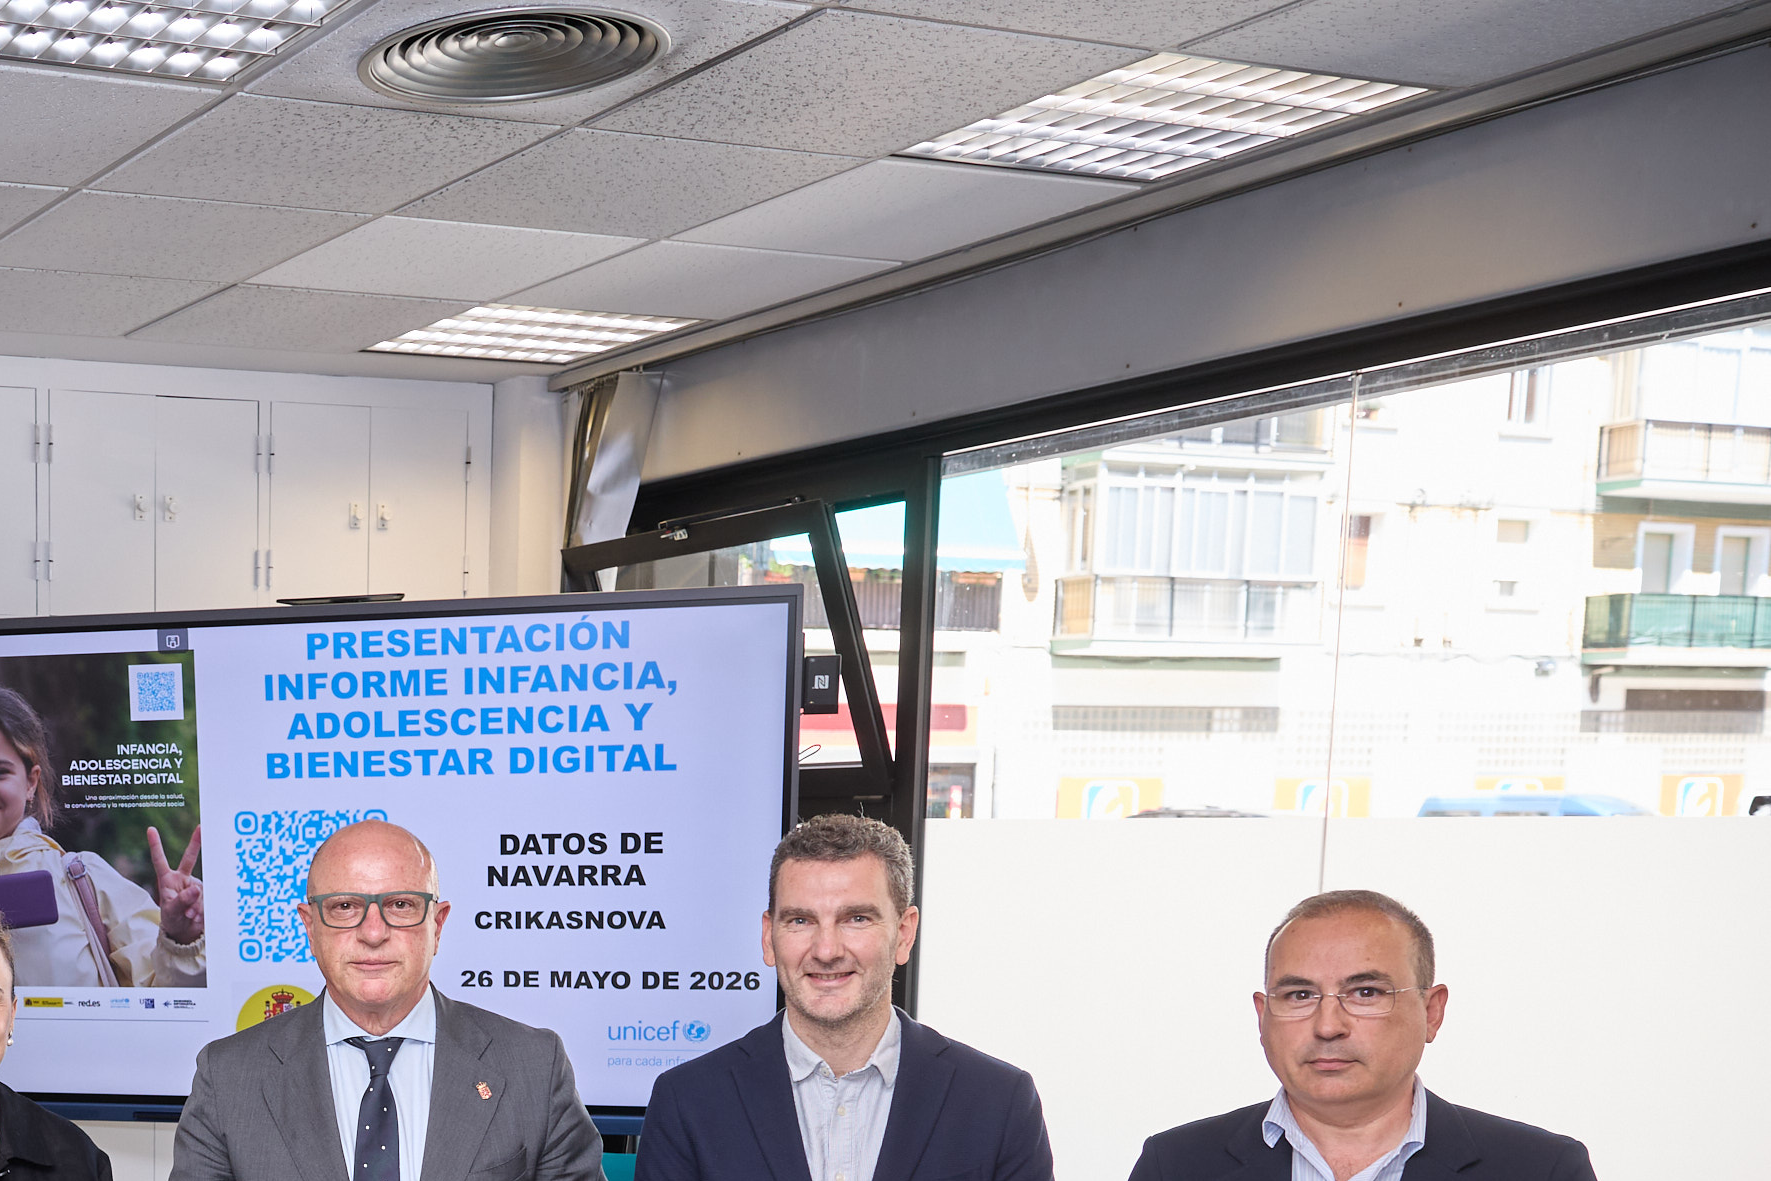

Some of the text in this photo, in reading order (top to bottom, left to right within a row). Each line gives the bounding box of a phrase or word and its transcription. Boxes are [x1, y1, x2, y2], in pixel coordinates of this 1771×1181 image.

[306, 614, 631, 661] PRESENTACIÓN
[264, 661, 678, 702] INFORME INFANCIA,
[287, 702, 654, 740] ADOLESCENCIA Y
[116, 743, 183, 756] INFANCIA,
[69, 757, 183, 771] ADOLESCENCIA Y
[266, 743, 678, 779] BIENESTAR DIGITAL
[61, 772, 184, 786] BIENESTAR DIGITAL
[499, 831, 664, 856] DATOS DE
[486, 864, 647, 887] NAVARRA
[474, 910, 667, 930] CRIKASNOVA
[460, 970, 761, 991] 26 DE MAYO DE 2026
[78, 999, 101, 1008] red.es
[607, 1020, 680, 1042] unicef
[607, 1056, 632, 1068] para
[635, 1055, 663, 1067] cada
